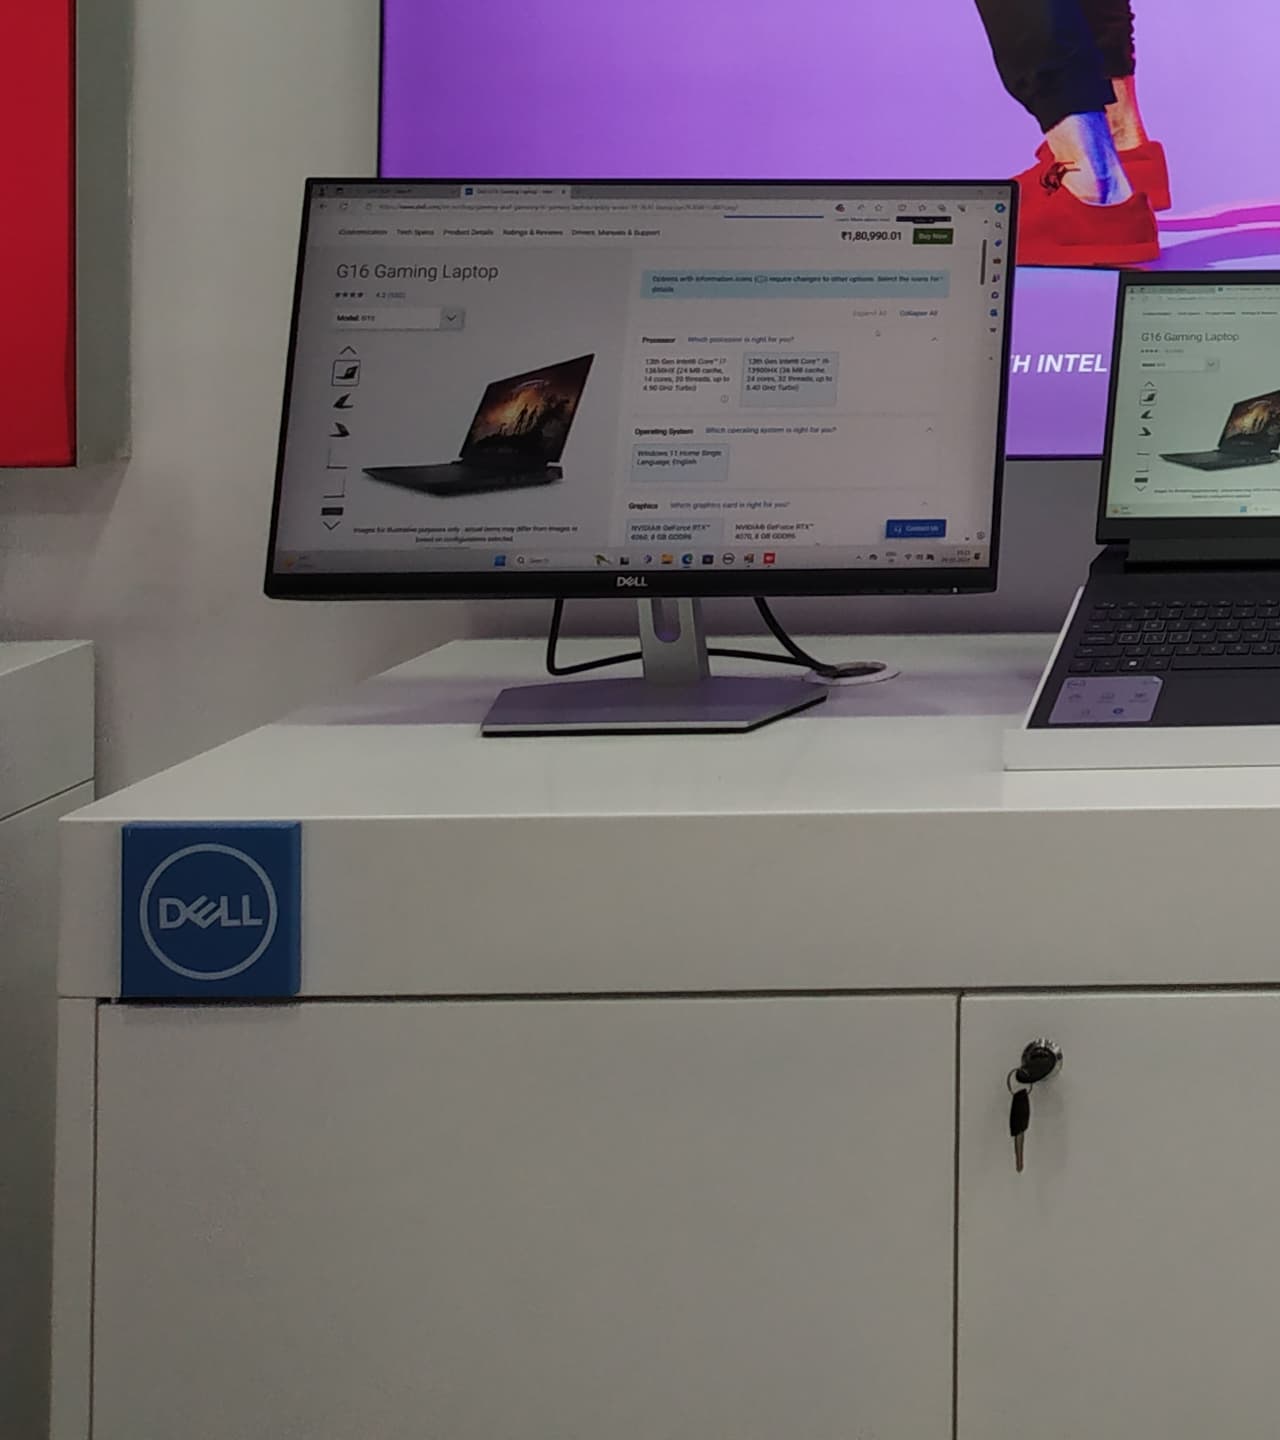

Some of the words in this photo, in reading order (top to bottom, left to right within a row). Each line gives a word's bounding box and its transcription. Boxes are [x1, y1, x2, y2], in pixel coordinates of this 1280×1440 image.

[841, 231, 902, 242] ₹1,80,990.01
[336, 264, 369, 279] G16
[374, 264, 437, 282] Gaming
[442, 265, 499, 282] Laptop
[1141, 333, 1161, 342] G16
[1164, 333, 1202, 343] Gaming
[1205, 333, 1239, 343] Laptop
[1037, 354, 1107, 373] INTEL
[617, 576, 648, 587] DELL
[159, 894, 263, 929] DELL
